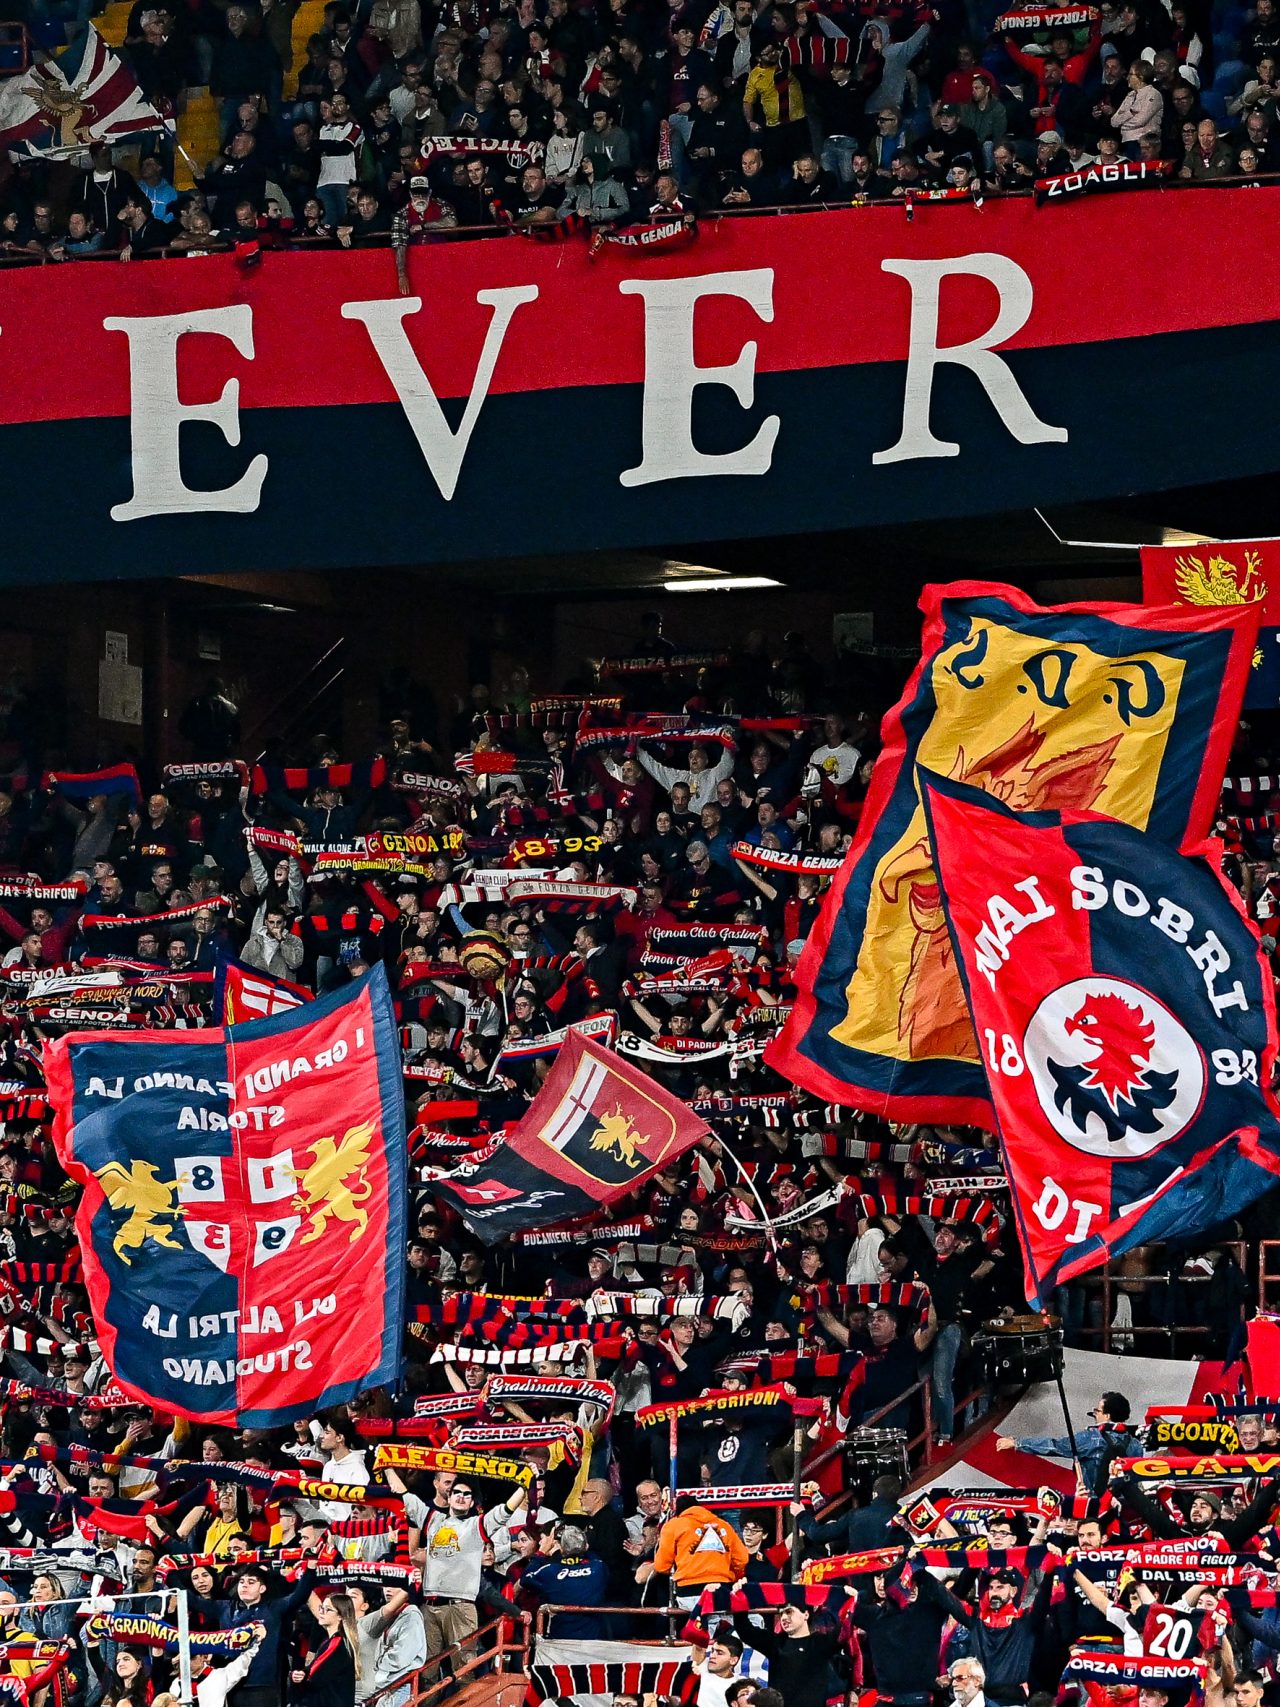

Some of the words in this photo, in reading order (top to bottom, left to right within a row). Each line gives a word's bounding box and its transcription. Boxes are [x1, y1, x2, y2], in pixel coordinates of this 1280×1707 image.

[1045, 11, 1088, 27] FORZA
[1046, 163, 1147, 197] ZOAGLI
[641, 221, 683, 245] GENOA
[103, 251, 1069, 523] EVER
[170, 762, 234, 776] GENOA
[403, 773, 462, 795] GENOA
[383, 833, 435, 855] GENOA
[563, 836, 601, 852] 93
[751, 848, 796, 868] FORZA
[538, 882, 571, 894] FORZA
[653, 926, 688, 940] Genoa
[691, 925, 716, 940] Club
[975, 875, 1056, 991] MAI
[1069, 863, 1249, 1020] SOBRI
[10, 967, 66, 982] GENOA
[133, 985, 164, 1000] NORD
[48, 1008, 127, 1023] GENOA
[984, 1026, 1024, 1079] 18
[1211, 1046, 1259, 1087] 93
[738, 1096, 785, 1108] GENOA
[1031, 1173, 1103, 1244] DI
[521, 1231, 570, 1247] BUCANIERI
[591, 1224, 640, 1241] ROSSOBLU
[490, 1378, 573, 1399] Gradinata
[717, 1391, 780, 1411] GRIFONI
[435, 1453, 532, 1488] GENOA
[348, 1563, 377, 1575] DELLA
[1146, 1553, 1184, 1566] PADRE
[1186, 1554, 1199, 1566] IN
[1201, 1554, 1238, 1567] FIGLIO
[1142, 1570, 1174, 1581] DAL
[1178, 1569, 1217, 1581] 1893
[189, 1632, 226, 1647] NORD
[1149, 1613, 1194, 1661] 20
[1140, 1665, 1200, 1679] GENOA
